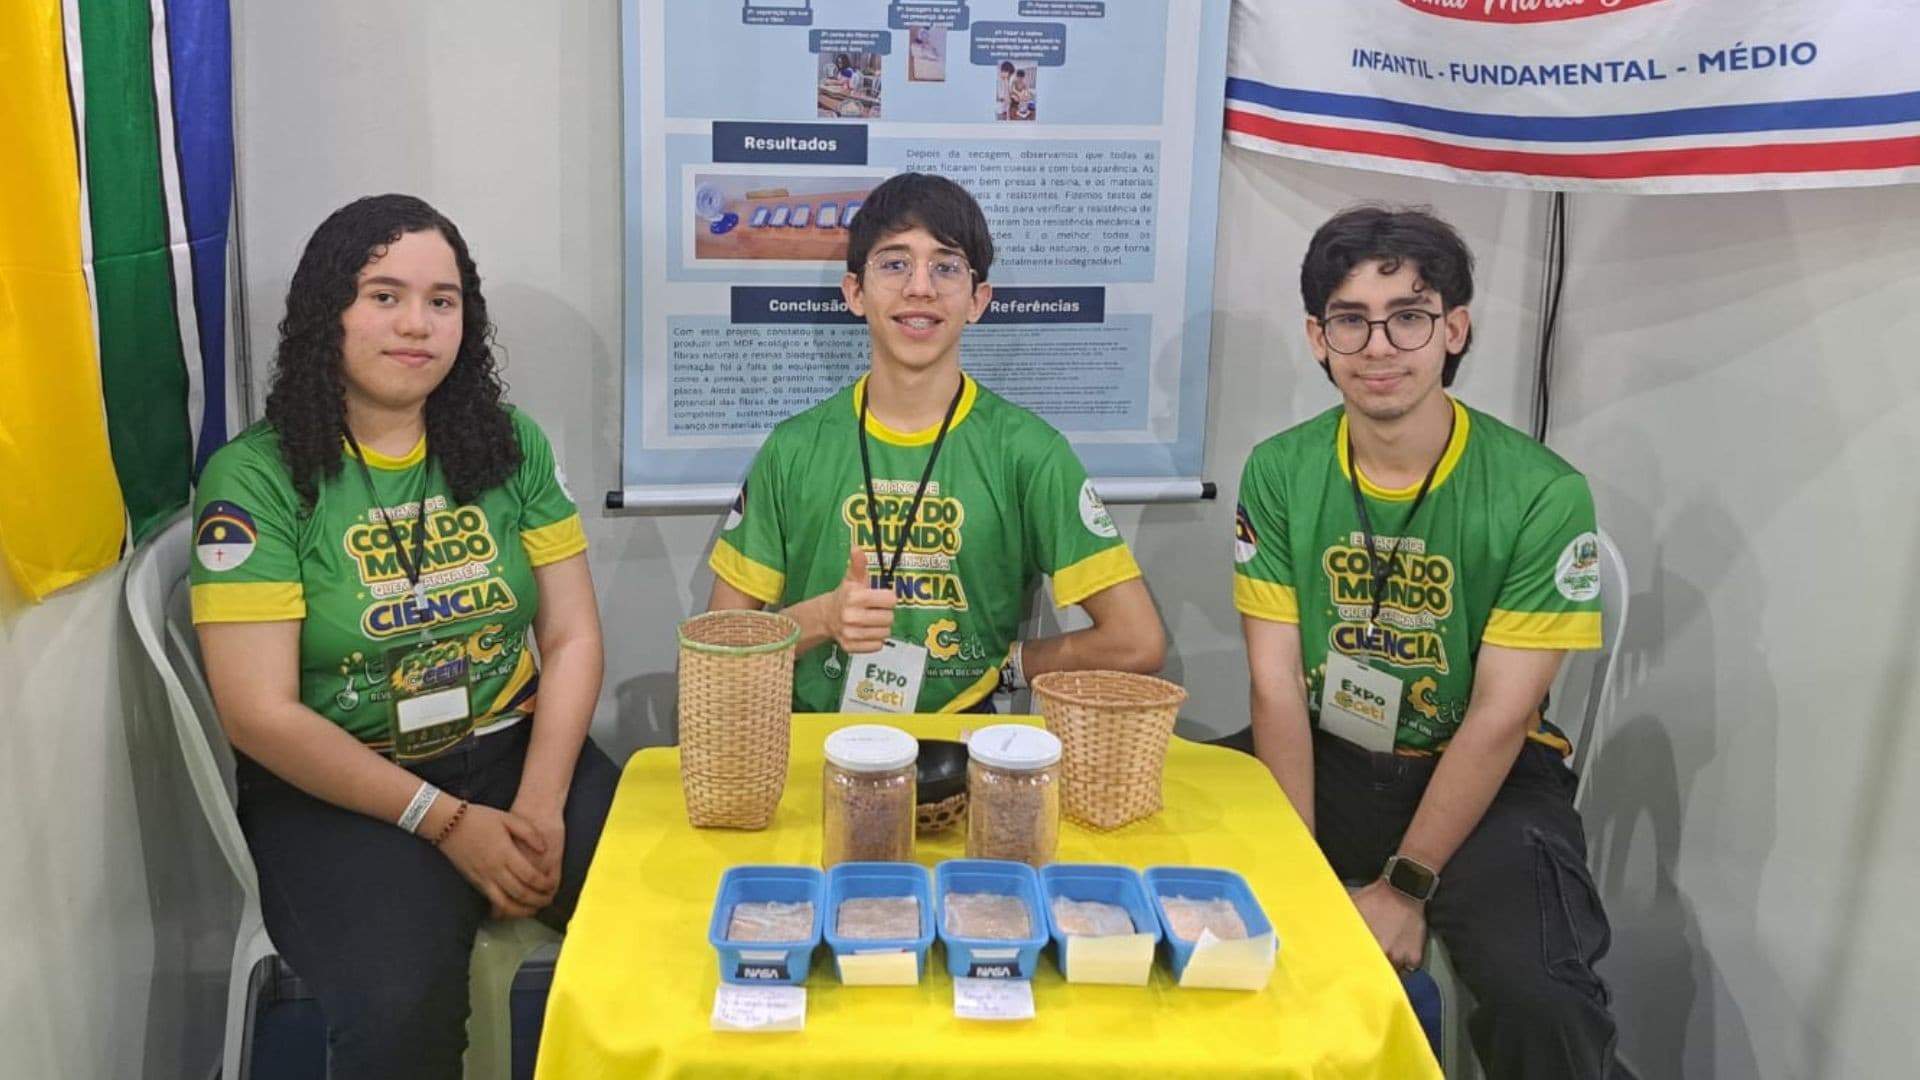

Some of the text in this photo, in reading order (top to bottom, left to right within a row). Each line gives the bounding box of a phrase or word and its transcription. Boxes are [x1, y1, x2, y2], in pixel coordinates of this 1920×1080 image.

[1352, 48, 1435, 80] INFANTIL
[1450, 59, 1667, 86] FUNDAMENTAL
[1698, 41, 1818, 74] MÉDIO
[744, 136, 837, 151] Resultados
[1086, 152, 1103, 160] que
[769, 299, 848, 312] Conclusão
[990, 299, 1080, 312] Referências
[924, 501, 957, 524] DO
[436, 510, 481, 542] DO
[1411, 559, 1449, 585] DO
[369, 580, 509, 631] CIÊNCIA
[744, 967, 779, 979] NASA
[976, 966, 1011, 978] NASA
